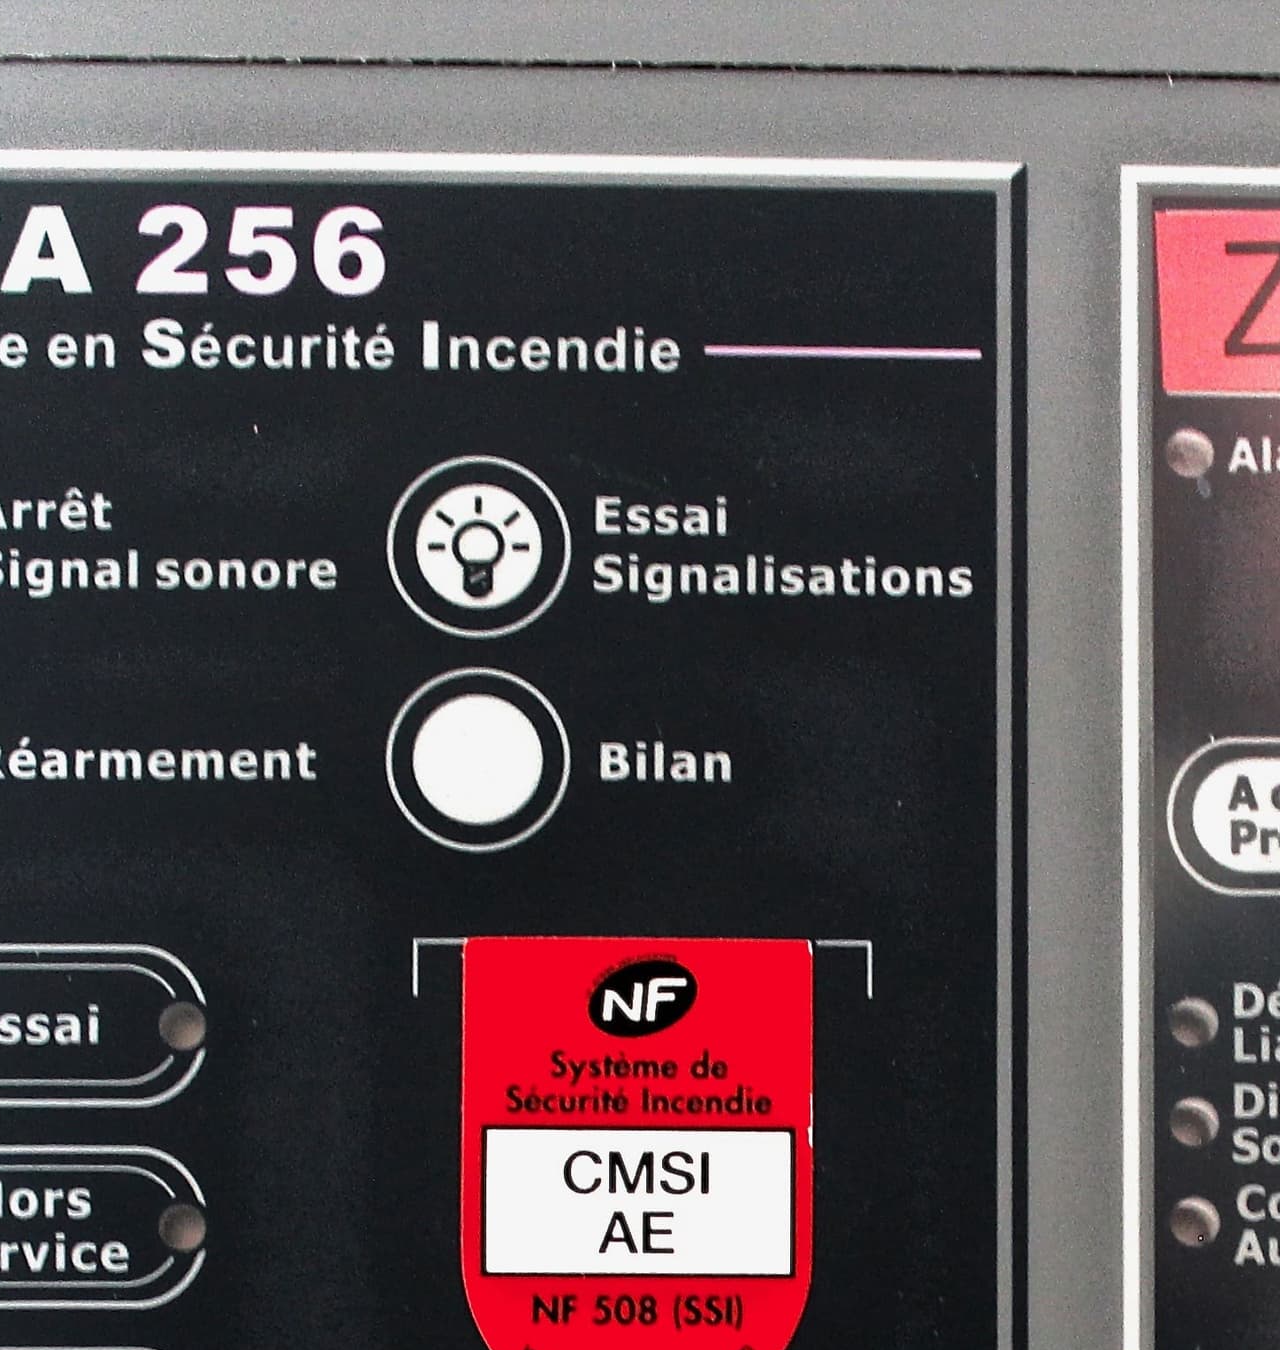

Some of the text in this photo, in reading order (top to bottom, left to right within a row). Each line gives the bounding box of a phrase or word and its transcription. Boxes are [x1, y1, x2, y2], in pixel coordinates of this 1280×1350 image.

[137, 205, 385, 295] 256
[48, 334, 114, 367] en
[143, 319, 394, 369] Sécurité
[423, 321, 680, 371] Incendie
[596, 497, 726, 535] Essai
[157, 559, 336, 589] sonore
[594, 554, 972, 602] Signalisations
[601, 742, 730, 781] Bilan
[602, 977, 688, 1022] NF
[549, 1048, 729, 1086] Système de
[505, 1083, 773, 1116] Sécurité Incendie
[564, 1151, 709, 1194] CMSI
[599, 1212, 674, 1253] AE
[531, 1294, 745, 1329] NF 508 (SSI)
